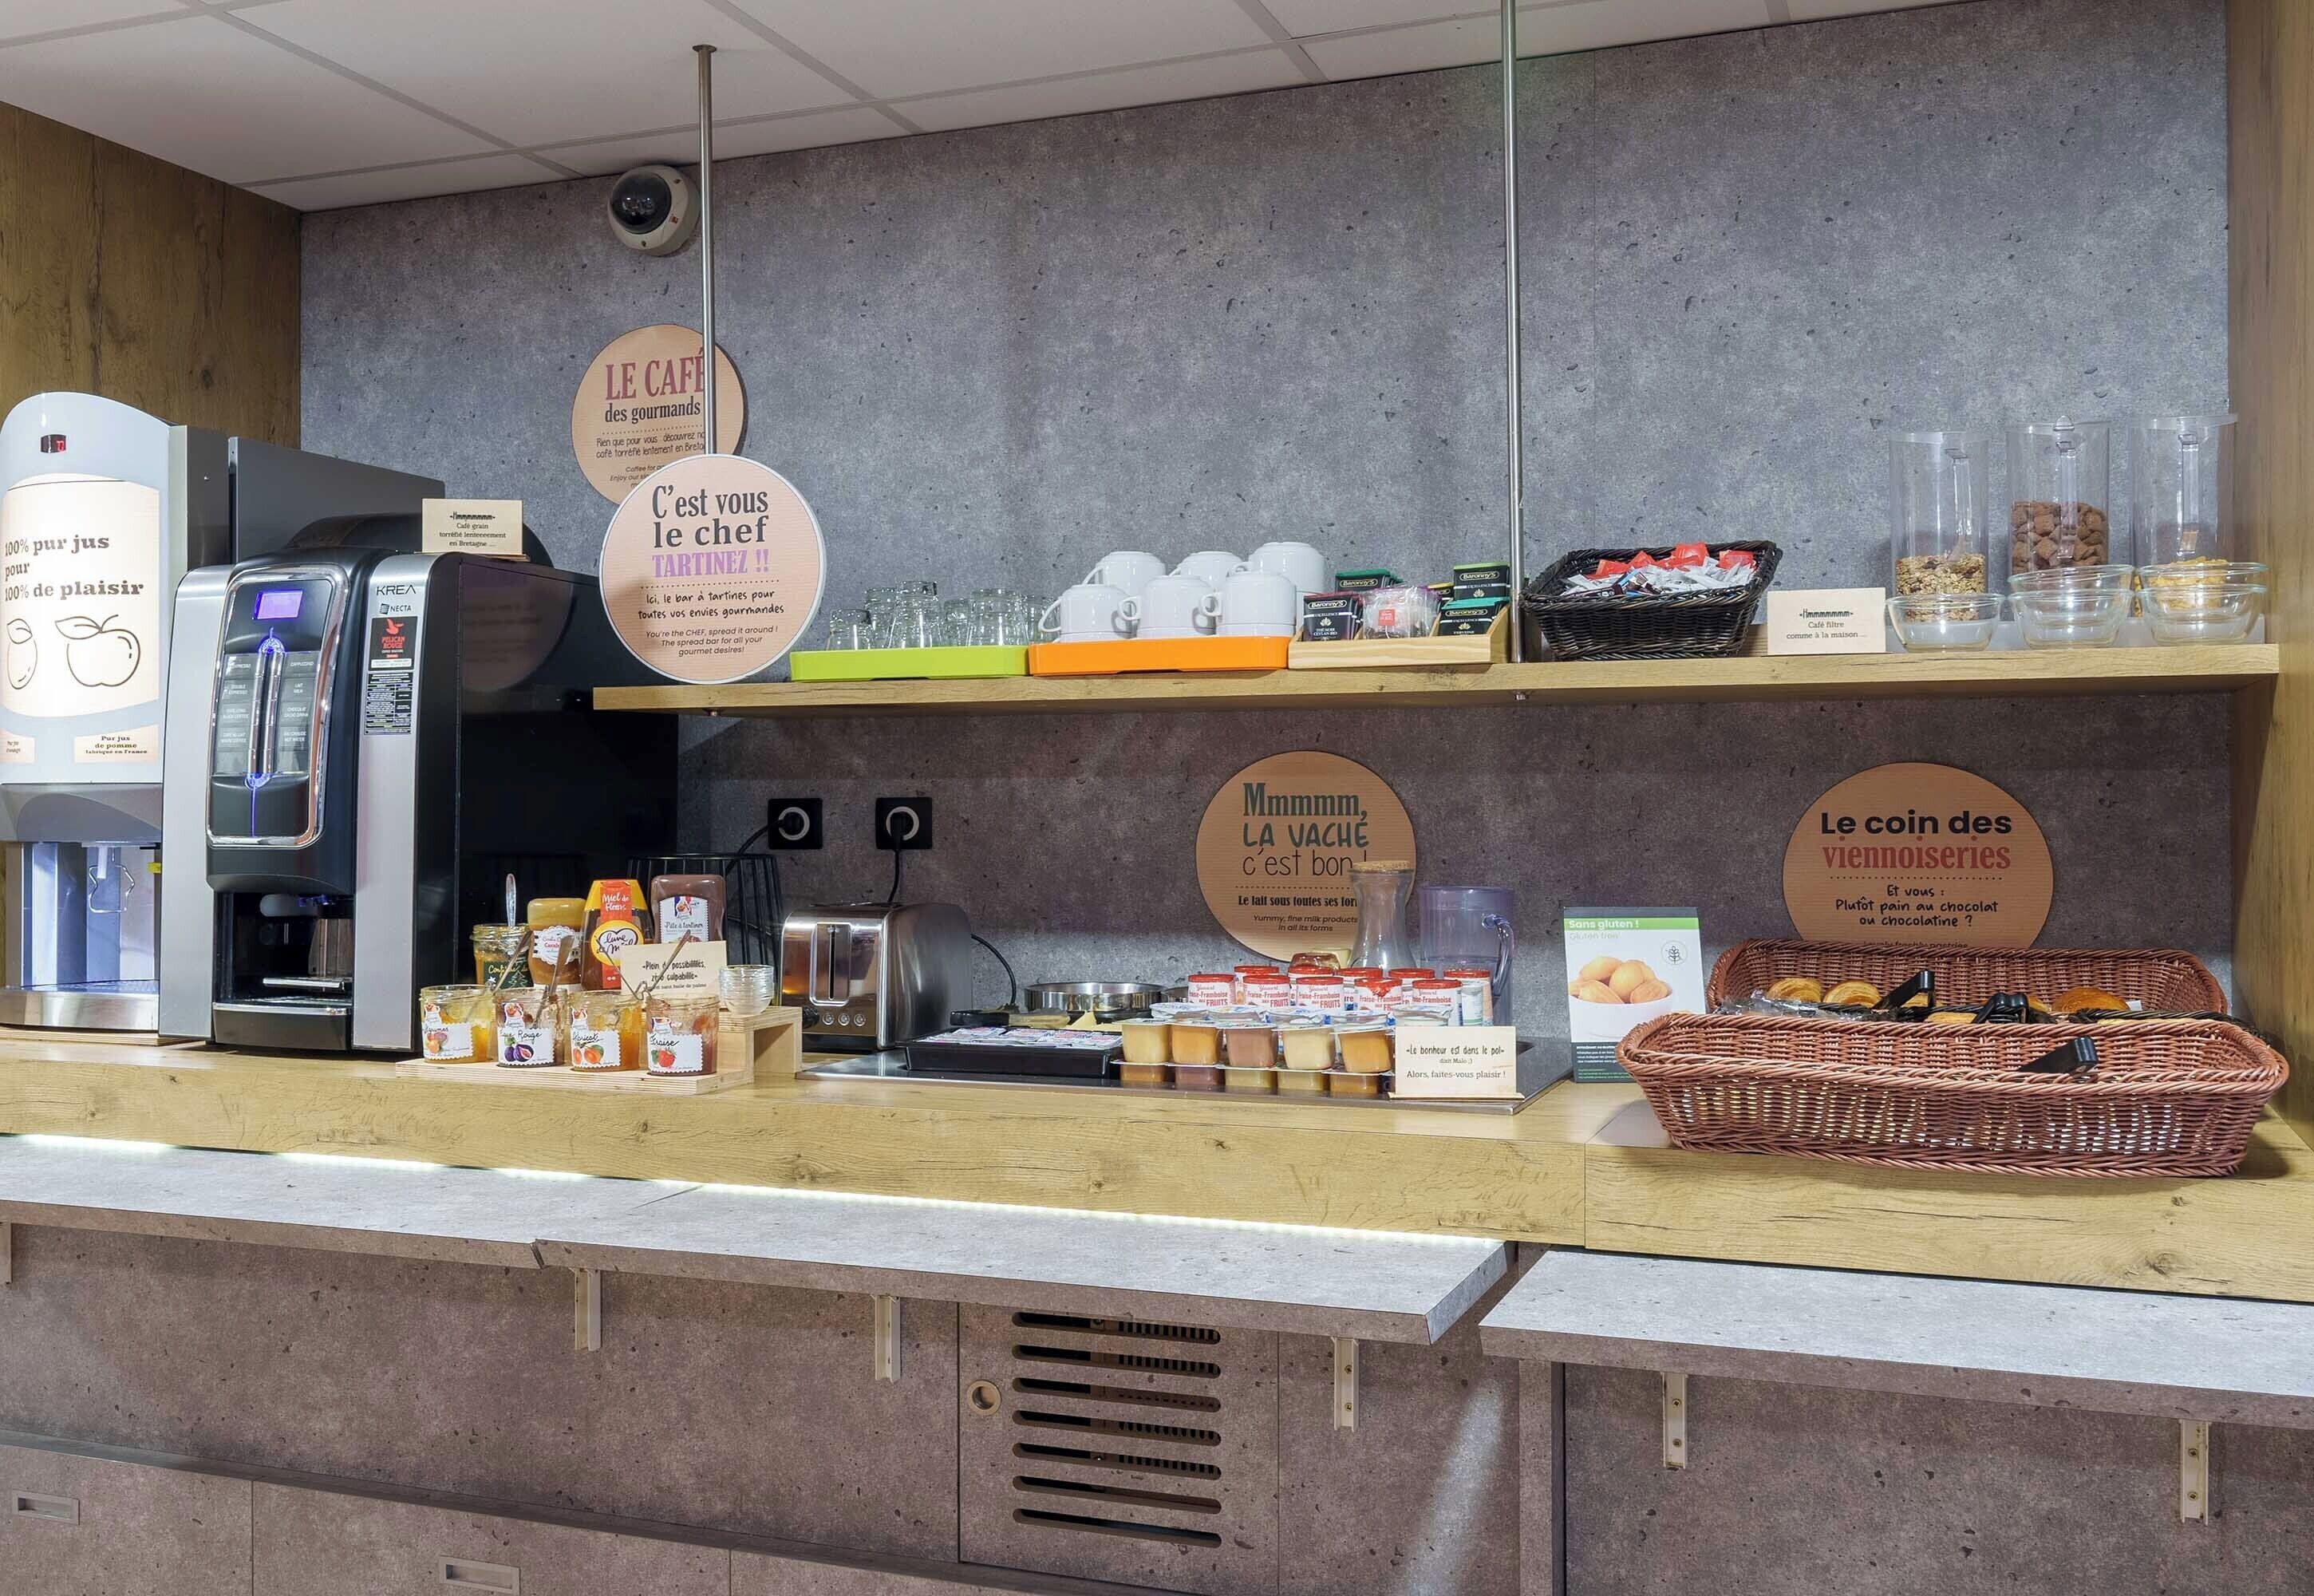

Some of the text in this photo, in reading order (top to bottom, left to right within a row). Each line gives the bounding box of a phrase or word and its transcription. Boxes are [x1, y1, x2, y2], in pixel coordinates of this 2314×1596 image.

[606, 362, 636, 400] LE
[605, 396, 701, 424] des gourmands
[596, 437, 611, 447] Rien
[613, 439, 625, 448] que
[626, 437, 641, 448] pour
[663, 431, 695, 442] découvrez
[596, 448, 613, 458] café
[614, 446, 642, 457] torréfié
[643, 444, 673, 456] lentement
[652, 484, 768, 519] C'est vous
[654, 516, 769, 548] le chef
[5, 535, 109, 557] 100% pur jus
[652, 548, 769, 579] TARTINEZ !!
[5, 562, 30, 582] pour
[5, 579, 144, 602] 100% de plaisir
[646, 590, 776, 605] Ici, le bar à tartines pour
[638, 603, 784, 619] toutes vos envies gourmandes
[709, 628, 736, 638] spread
[744, 626, 773, 634] around
[677, 638, 704, 648] spread
[744, 637, 763, 646] your
[678, 648, 713, 658] gourmet
[1243, 782, 1368, 821] Mmmmm,
[1821, 809, 2012, 835] Le coin des
[1243, 822, 1369, 847] LA VACHE
[1822, 836, 2011, 869] viennoiseries
[1242, 847, 1301, 876] c'est
[1313, 850, 1353, 876] bon
[1886, 884, 1900, 897] Et
[1904, 886, 1936, 897] vous
[602, 892, 621, 904] Miel
[1238, 895, 1338, 907] Le lait sous toutes ses
[1835, 895, 1999, 915] Plutôt pain au chocolat
[605, 903, 627, 912] Fleurs
[664, 921, 677, 930] Pâte
[1253, 915, 1285, 923] Yummy,
[1322, 916, 1358, 925] products
[1569, 919, 1639, 930] Sans gluten !
[1859, 915, 1973, 927] ou chocolatine ?
[1570, 931, 1598, 940] Gluten
[1206, 998, 1228, 1007] FRUITS
[1270, 998, 1289, 1008] FRUITS
[1320, 999, 1341, 1009] FRUITS
[518, 1029, 543, 1045] Rouge
[1420, 1045, 1447, 1055] bonheur
[1451, 1045, 1460, 1055] est
[1463, 1045, 1479, 1055] dans
[1482, 1045, 1487, 1054] le
[1407, 1070, 1429, 1079] Alors,
[1476, 1070, 1502, 1080] plaisir
